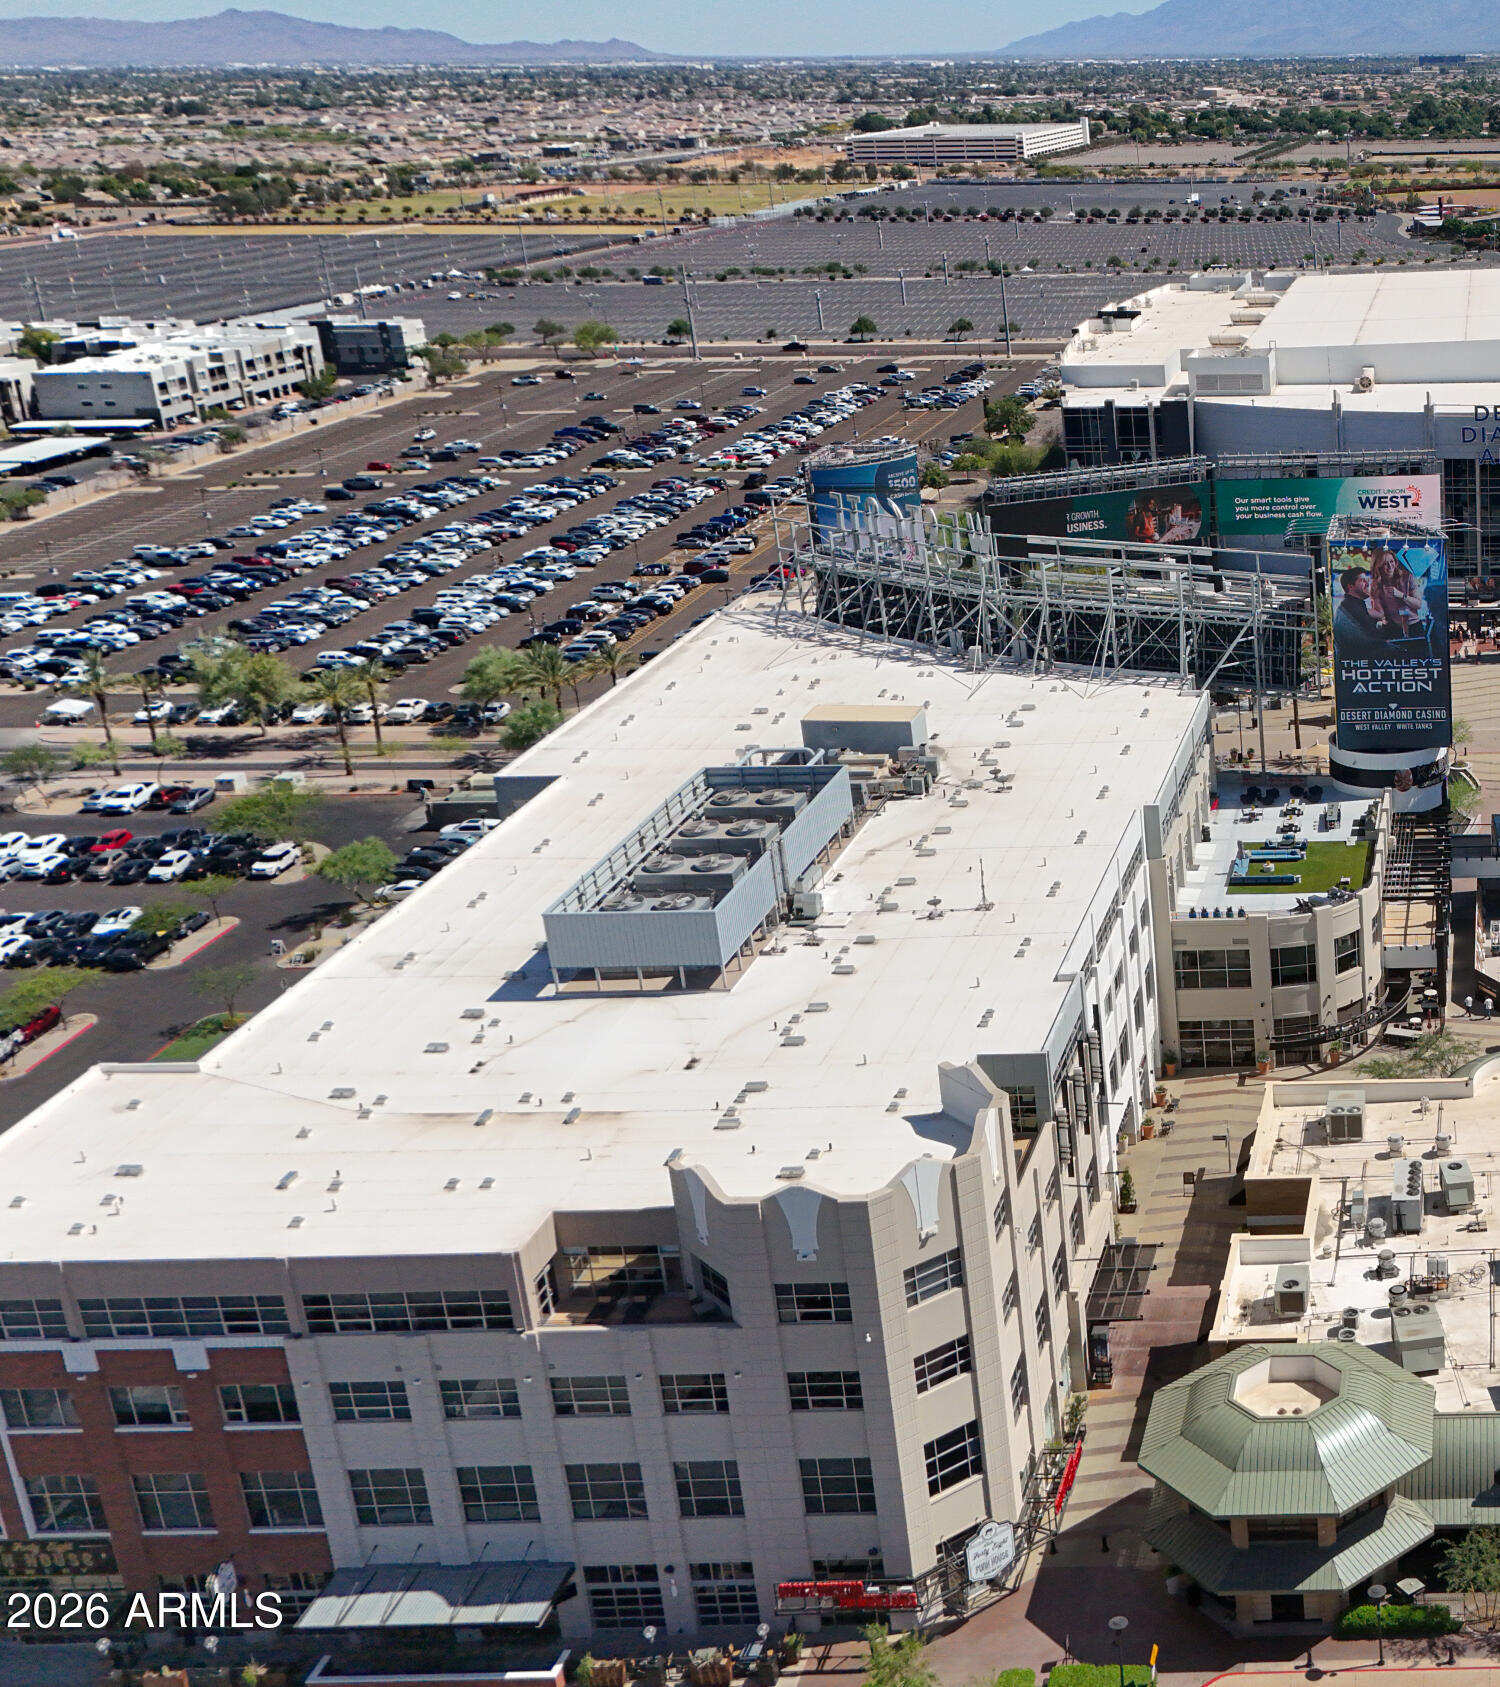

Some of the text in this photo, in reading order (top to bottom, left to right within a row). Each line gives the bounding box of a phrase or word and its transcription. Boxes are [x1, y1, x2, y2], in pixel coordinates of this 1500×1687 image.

[888, 475, 916, 488] $500
[1358, 495, 1412, 509] WEST
[1305, 510, 1324, 518] flow.
[1340, 658, 1442, 668] THE VALLEY'S
[1341, 668, 1442, 681] HOTTEST
[1352, 681, 1433, 693] ACTION
[1340, 709, 1447, 721] DESERT DIAMOND CASINO
[1371, 723, 1391, 731] VALLEY
[1415, 722, 1433, 730] TANKS
